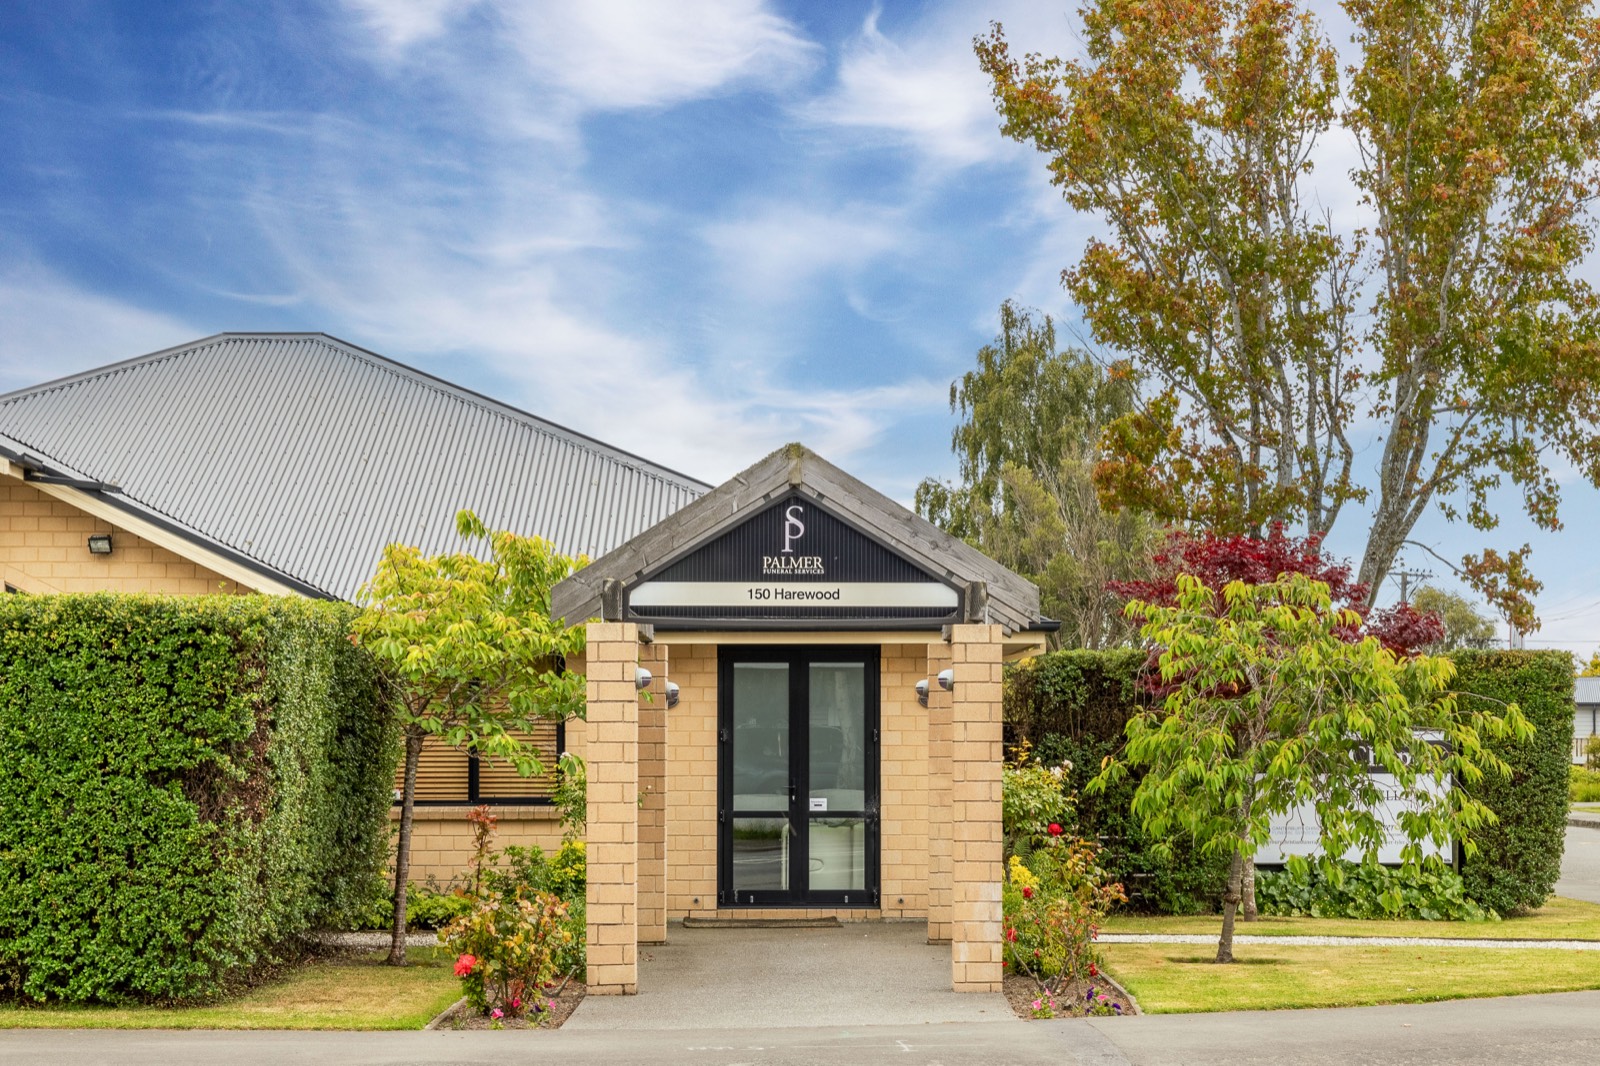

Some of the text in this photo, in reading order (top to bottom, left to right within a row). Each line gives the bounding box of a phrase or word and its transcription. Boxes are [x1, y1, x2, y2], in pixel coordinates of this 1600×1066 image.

[763, 556, 823, 569] PALMER
[747, 587, 840, 600] 150 Harewood
